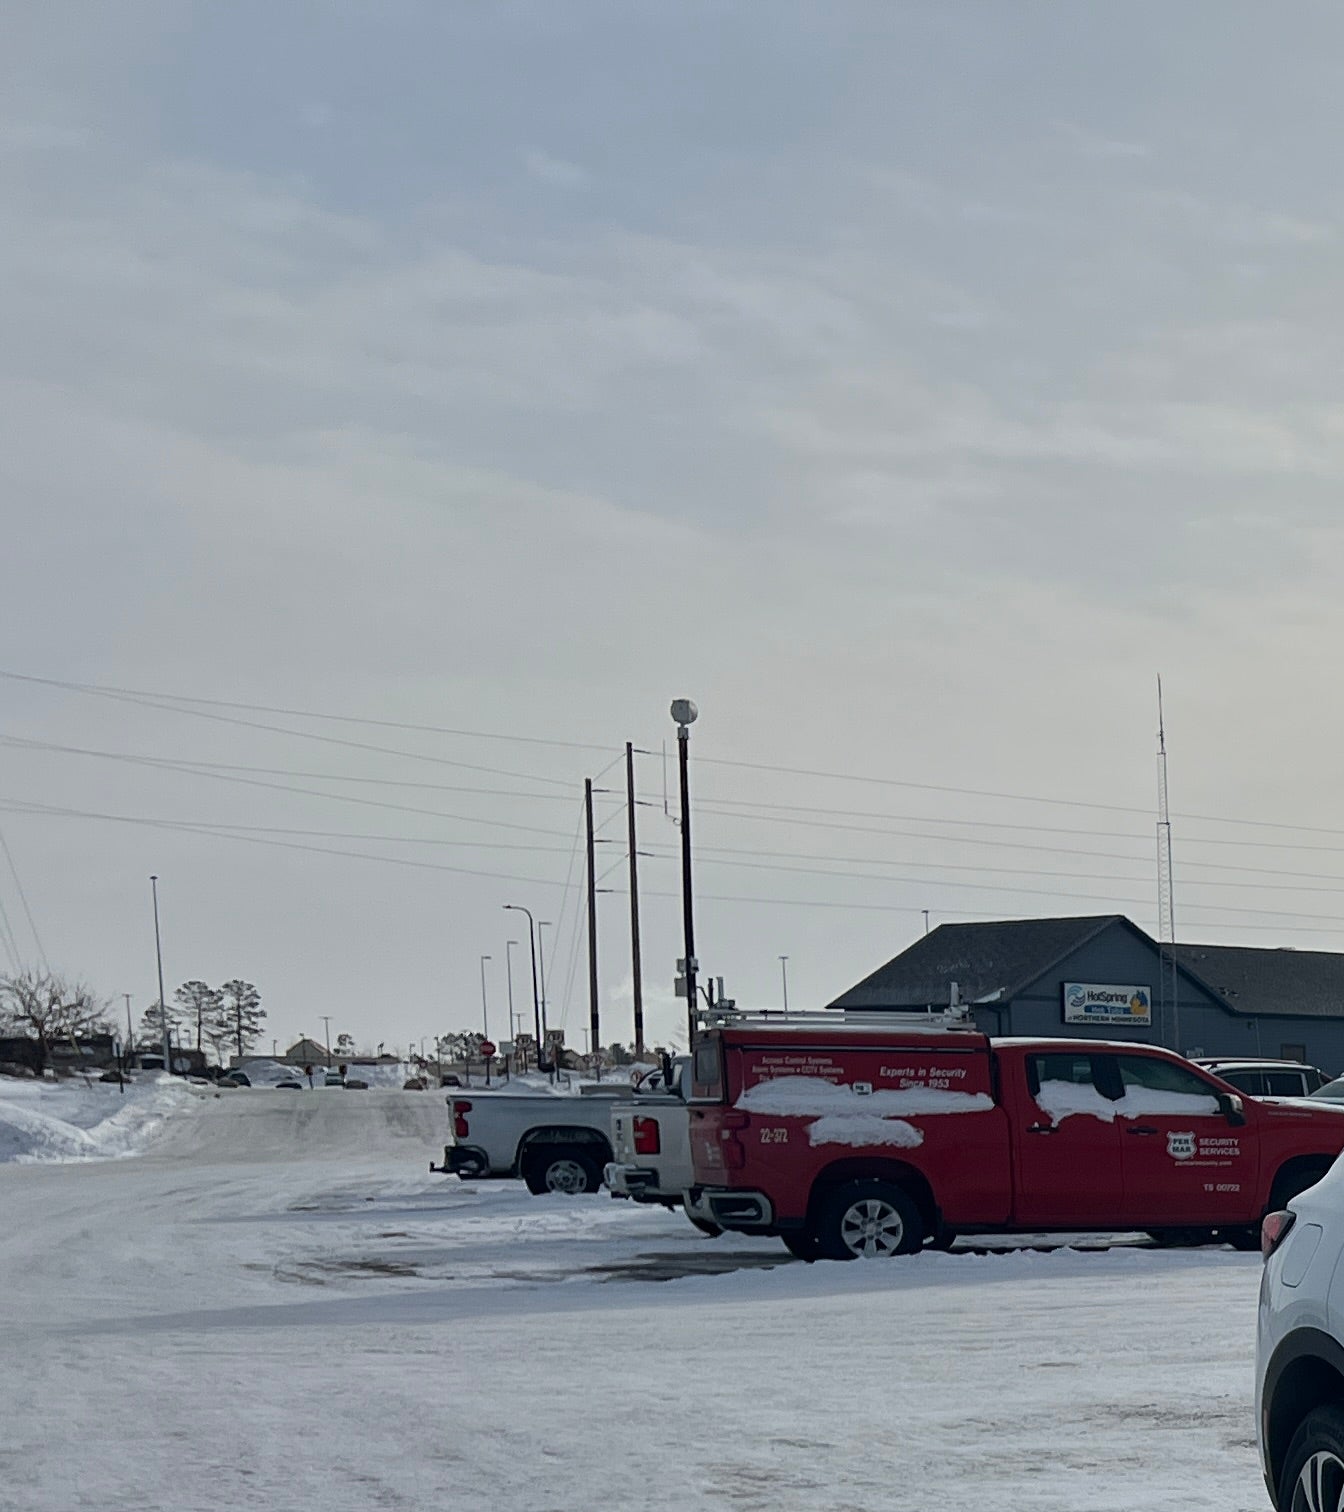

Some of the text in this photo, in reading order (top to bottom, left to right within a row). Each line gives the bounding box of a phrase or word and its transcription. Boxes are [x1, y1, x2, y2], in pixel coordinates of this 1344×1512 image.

[1087, 991, 1128, 1004] HotSpring
[880, 1066, 966, 1079] Experts in Security
[900, 1078, 949, 1088] Since 1953
[760, 1128, 788, 1143] 22-372
[1199, 1138, 1239, 1146] SECURITY
